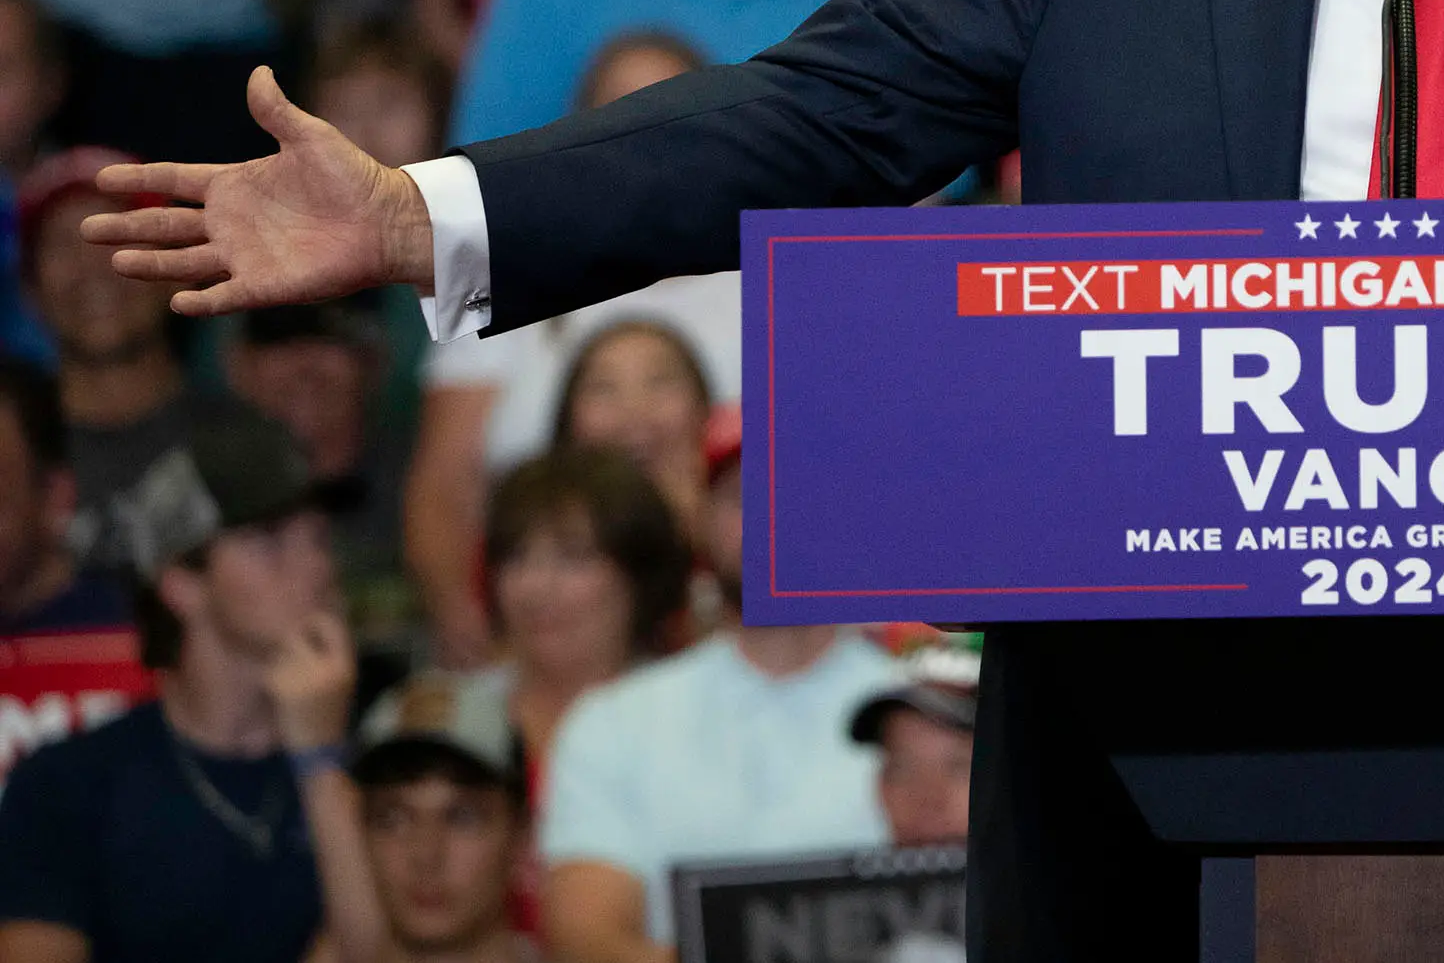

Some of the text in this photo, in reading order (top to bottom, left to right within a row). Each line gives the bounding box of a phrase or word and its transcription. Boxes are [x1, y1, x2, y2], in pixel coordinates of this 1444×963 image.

[981, 264, 1139, 312] TEXT
[1126, 527, 1222, 553] MAKE
[1235, 524, 1394, 551] AMERICA
